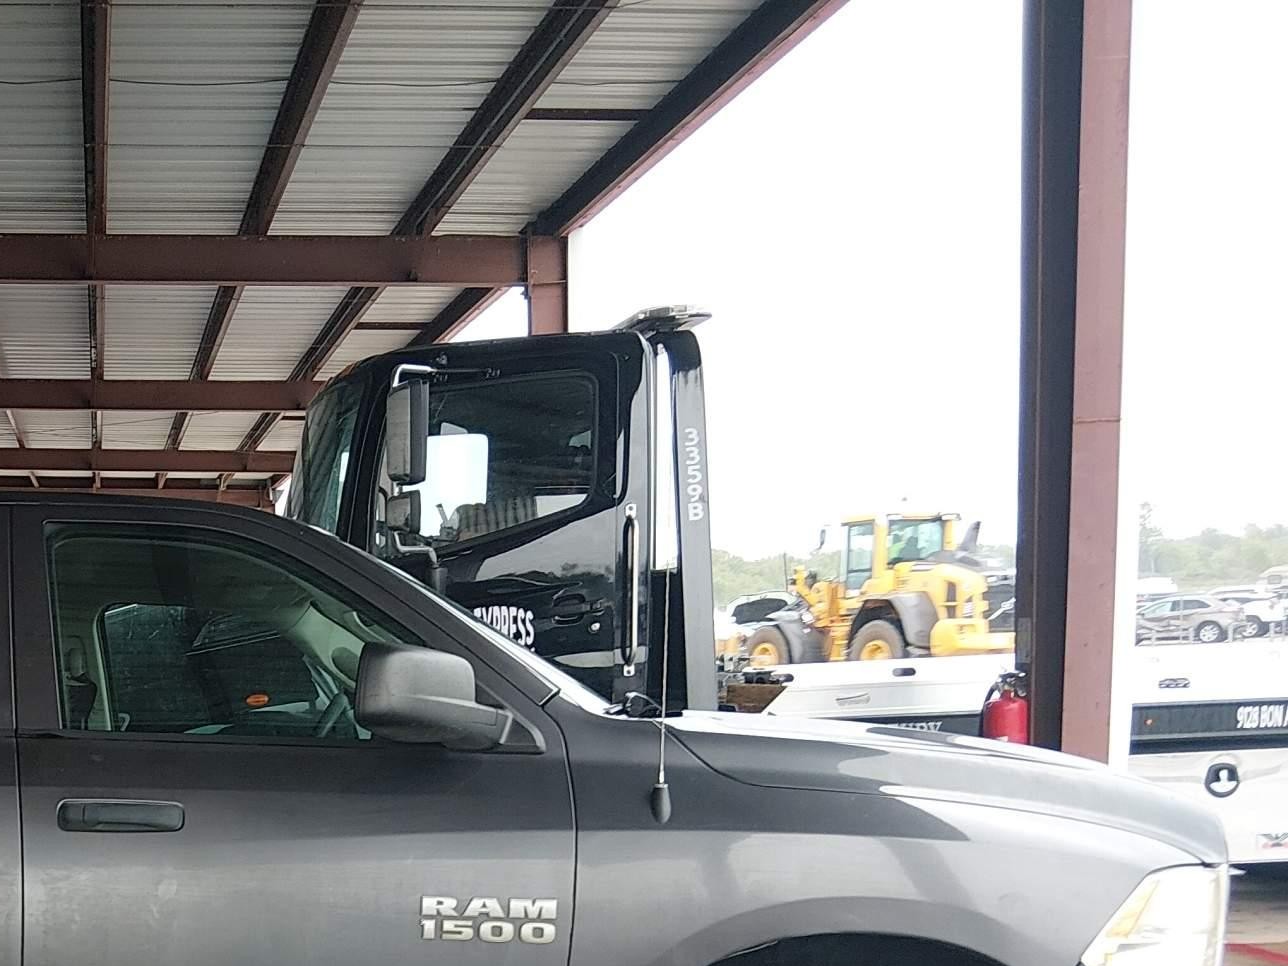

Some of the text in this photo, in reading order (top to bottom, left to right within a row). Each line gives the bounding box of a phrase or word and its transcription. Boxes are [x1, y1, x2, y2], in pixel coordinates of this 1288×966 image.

[684, 427, 705, 521] 3359B
[420, 895, 558, 920] RAM
[420, 919, 557, 945] 1500
